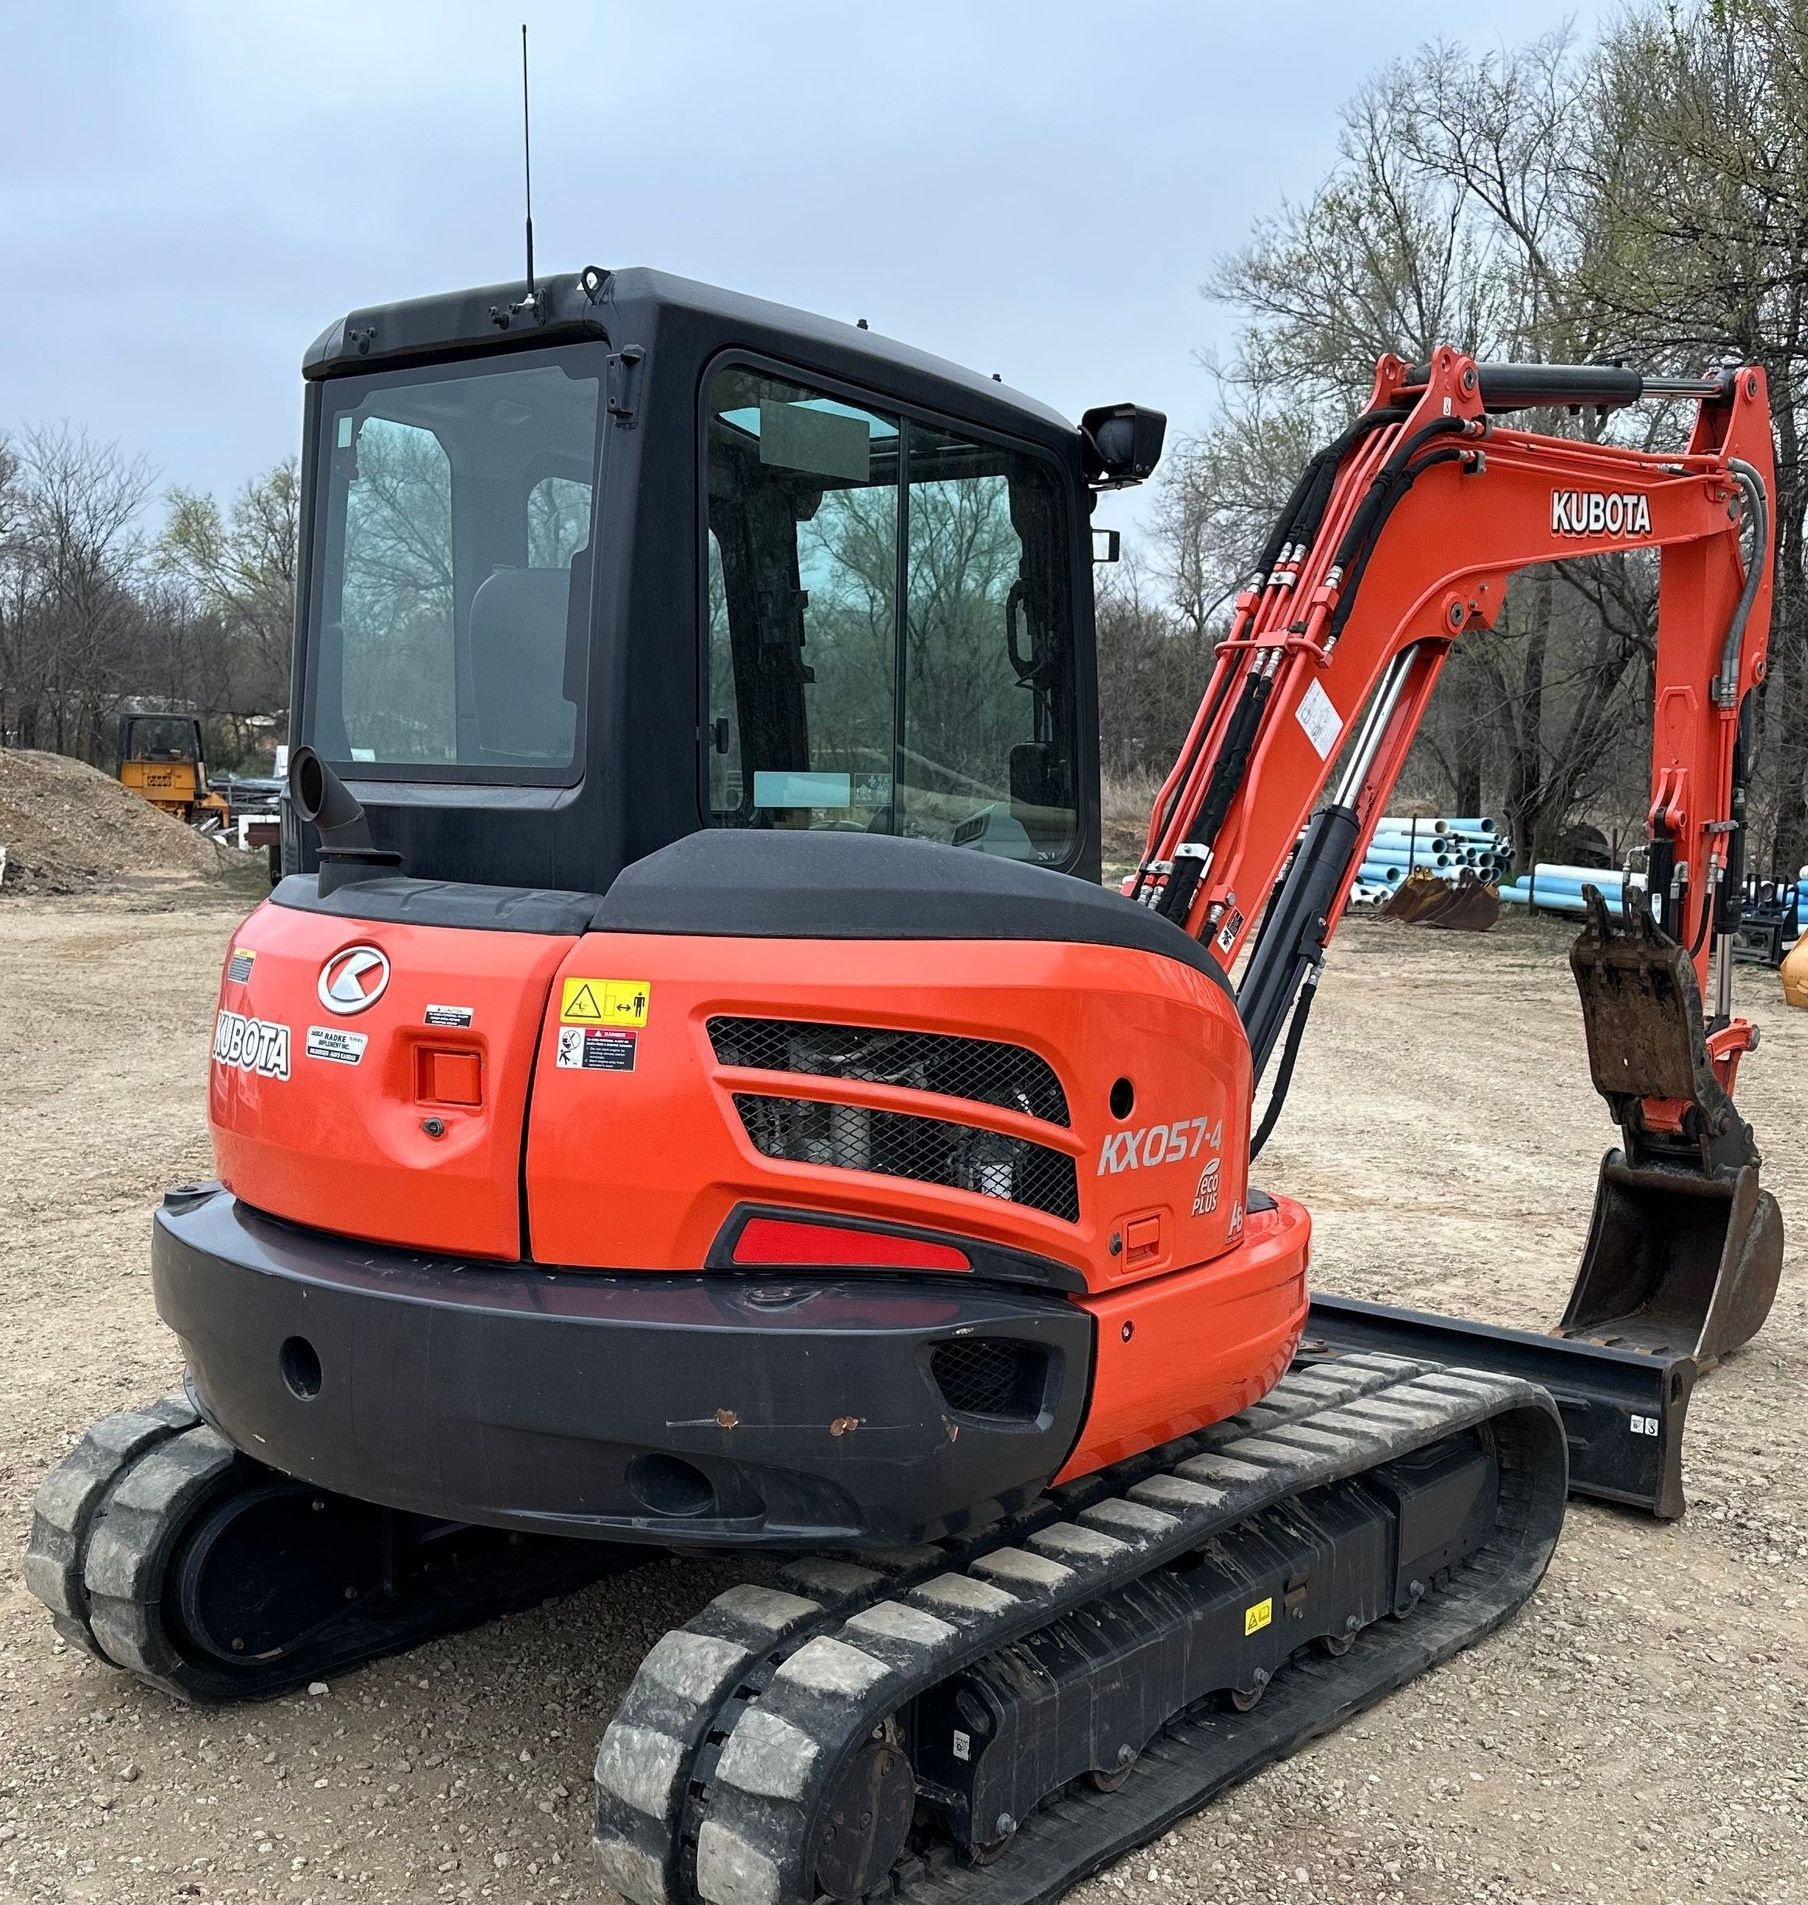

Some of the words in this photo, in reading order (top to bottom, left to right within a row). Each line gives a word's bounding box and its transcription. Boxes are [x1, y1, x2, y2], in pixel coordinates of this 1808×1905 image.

[1552, 490, 1653, 534] KUBOTA
[324, 1032, 347, 1043] RADKE
[1200, 1174, 1219, 1195] eco
[1191, 1193, 1218, 1217] PLUS
